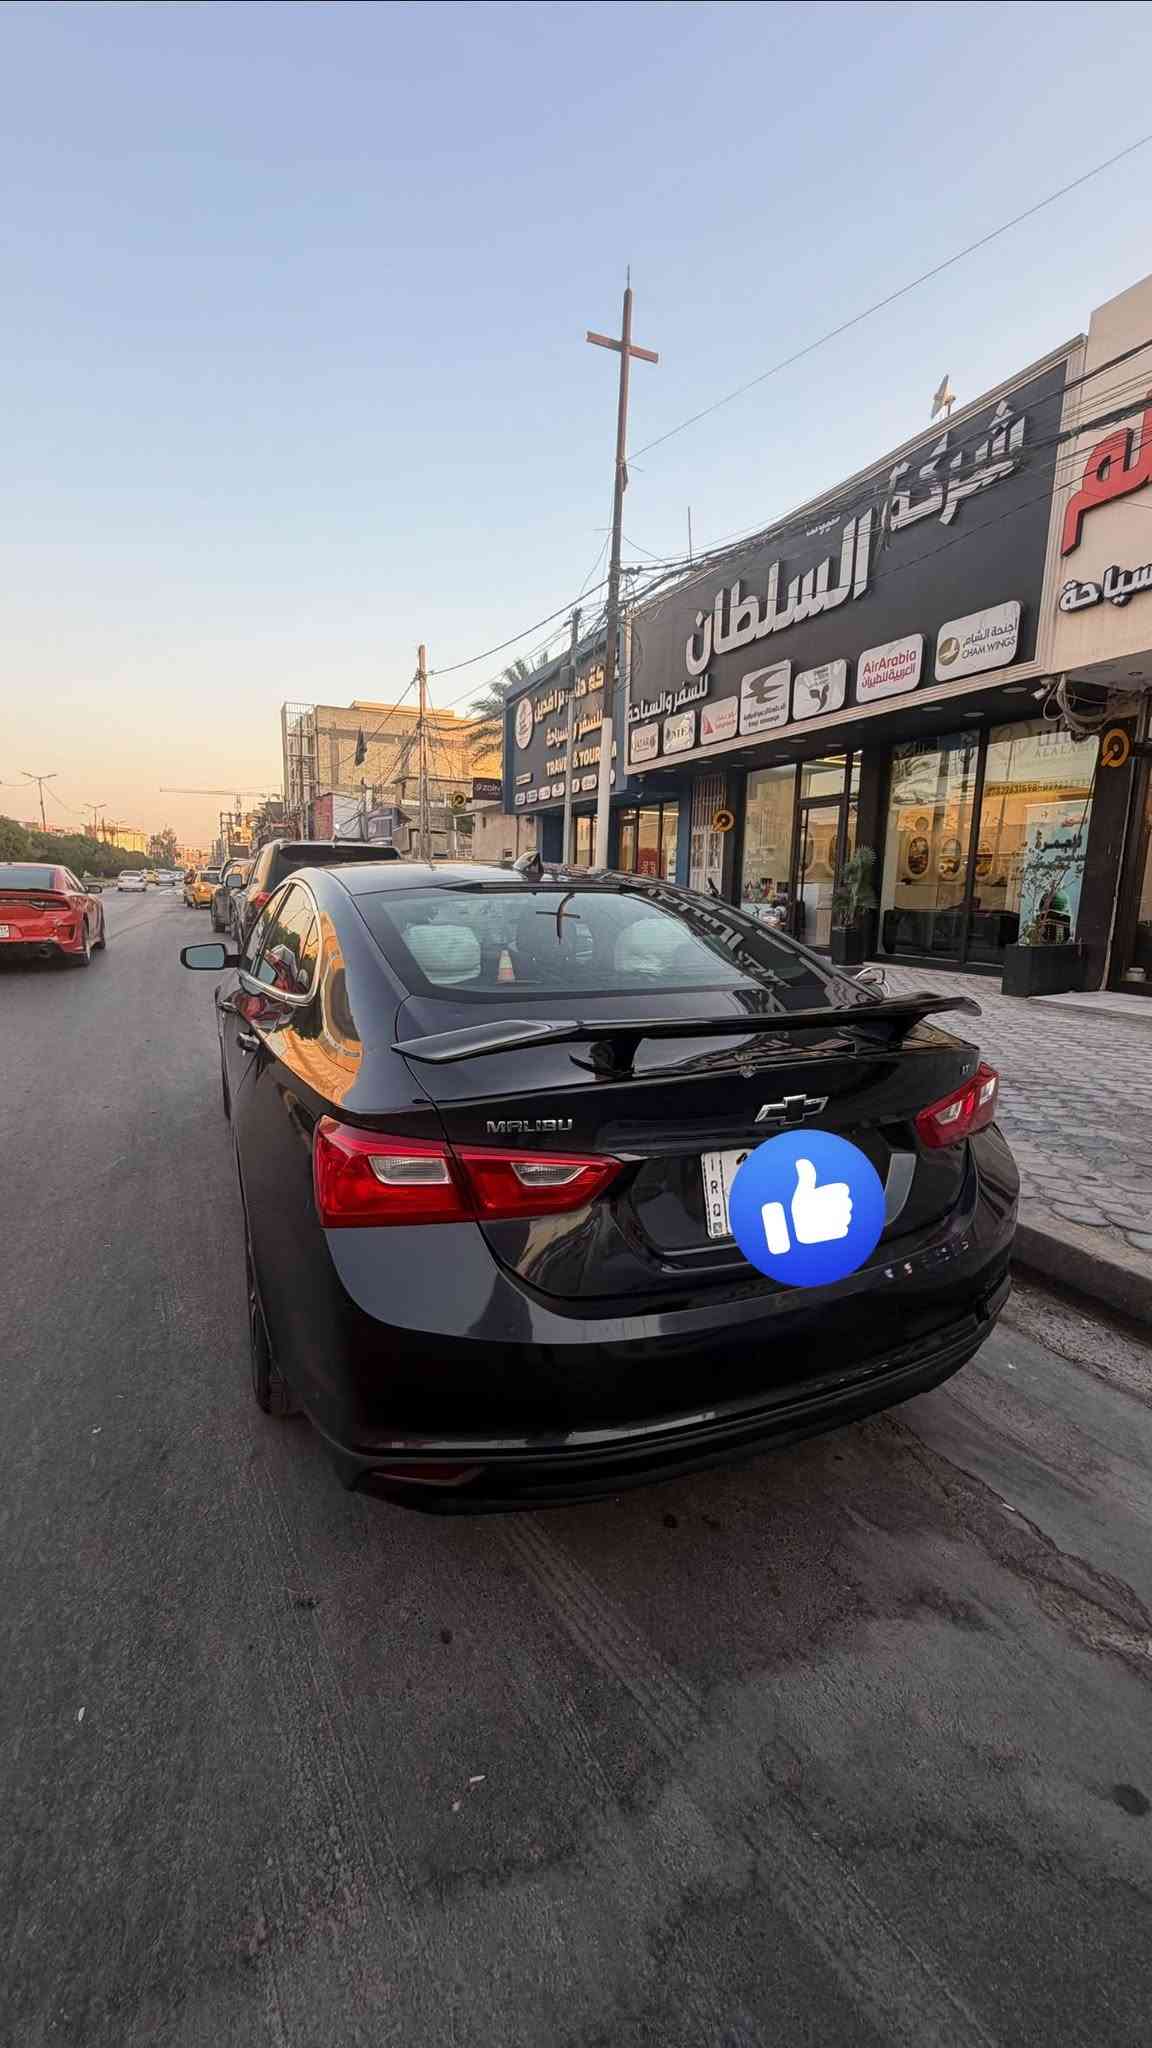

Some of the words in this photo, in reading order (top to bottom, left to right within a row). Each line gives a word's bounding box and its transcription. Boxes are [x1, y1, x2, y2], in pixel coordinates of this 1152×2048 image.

[686, 508, 873, 676] السلطان
[961, 645, 986, 659] CHAM
[986, 635, 1017, 652] WINGS
[672, 673, 709, 713] للسفر
[546, 756, 567, 777] TRAV
[486, 1118, 573, 1134] MALIBU
